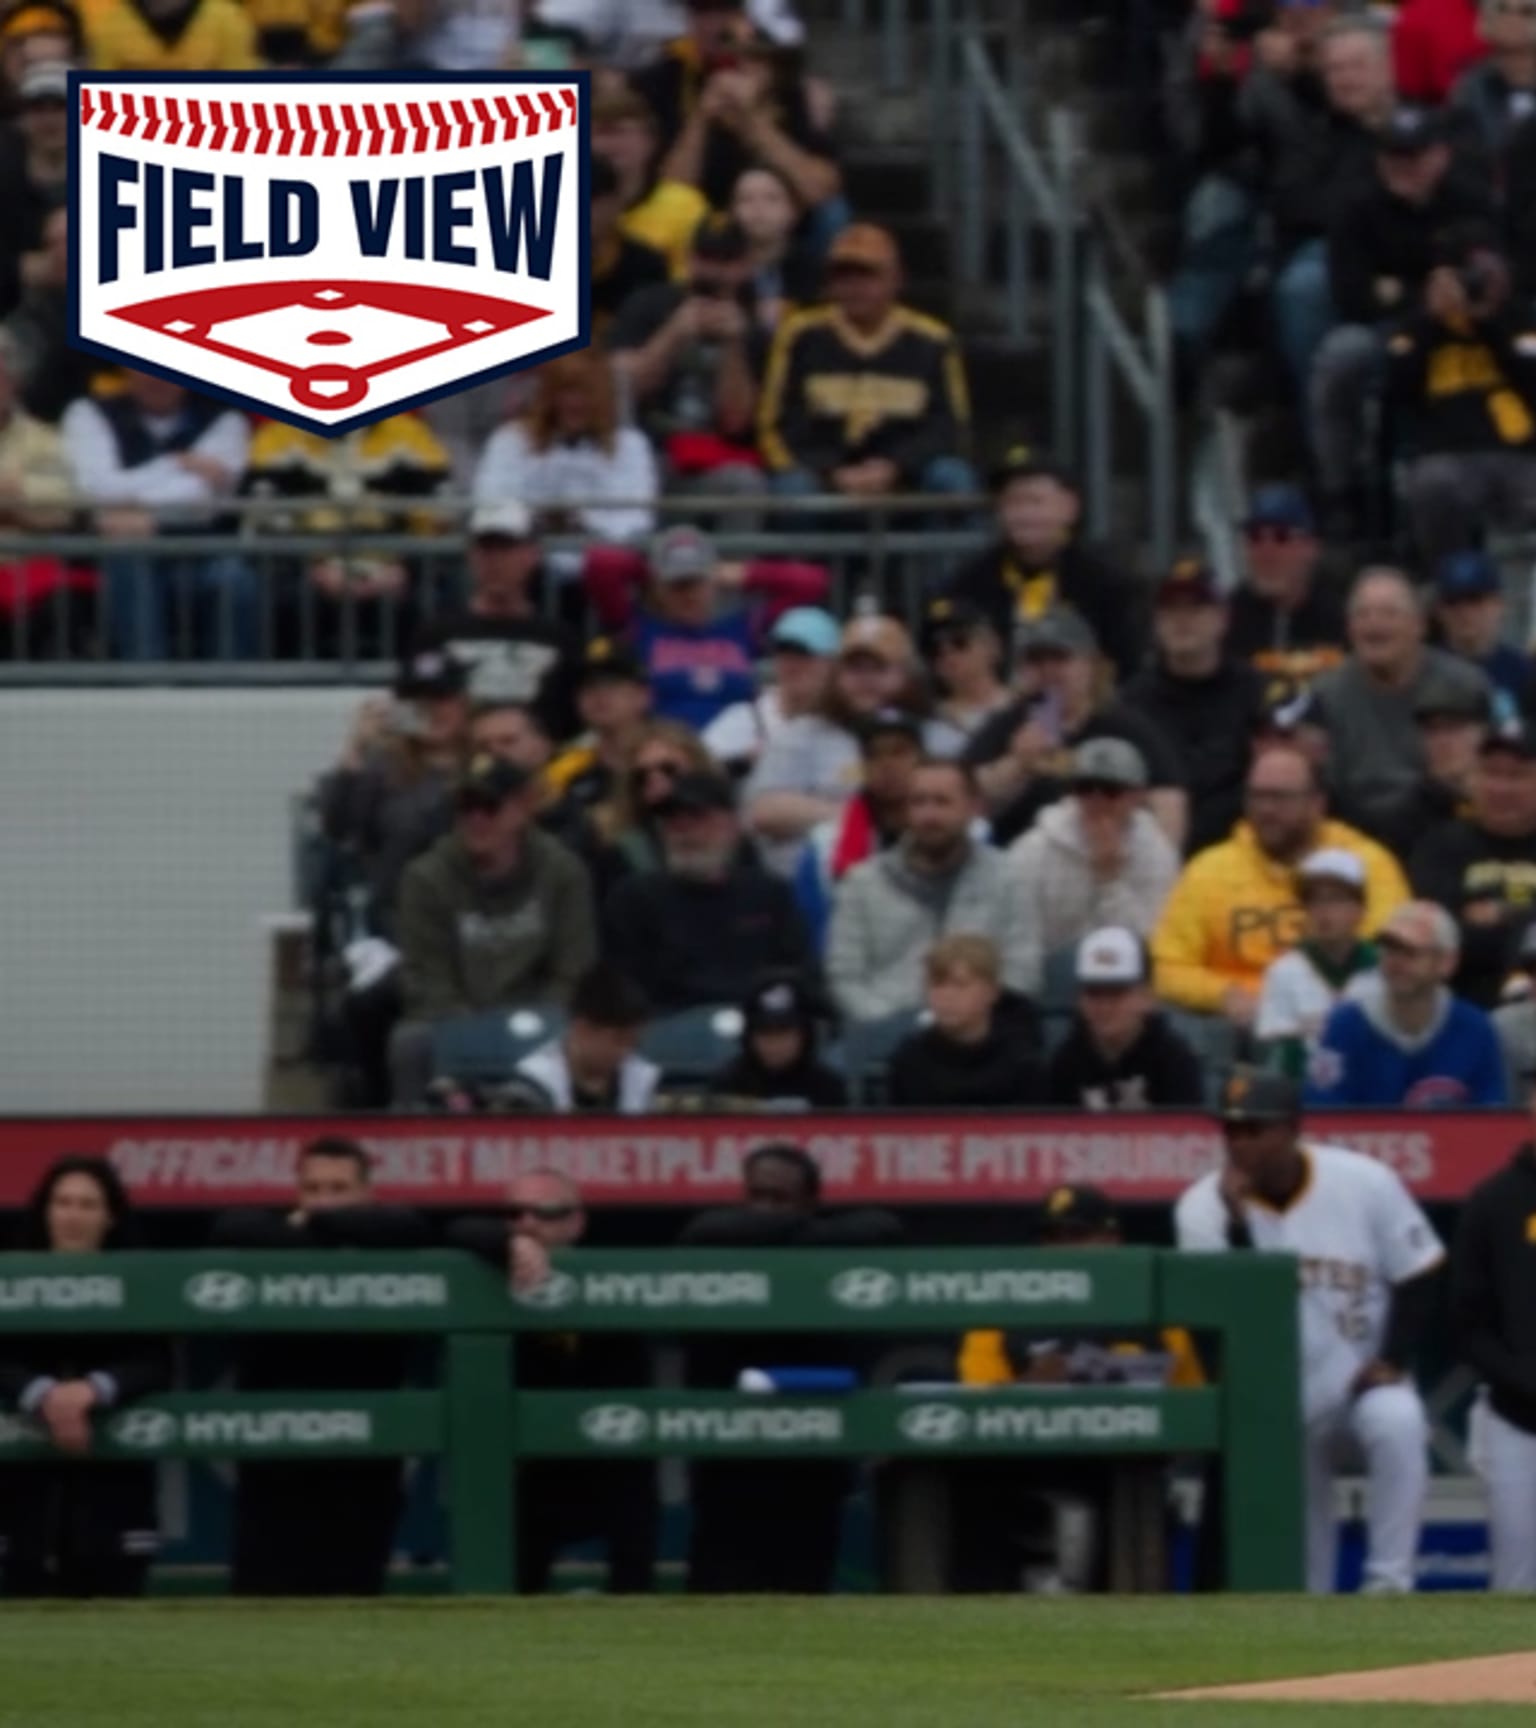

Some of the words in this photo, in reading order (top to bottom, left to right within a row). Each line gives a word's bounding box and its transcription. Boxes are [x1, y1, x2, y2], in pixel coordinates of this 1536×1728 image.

[111, 1138, 299, 1186] OFFICIAL
[355, 1137, 460, 1184] CKET
[472, 1136, 785, 1185] MARKETPLA
[871, 1136, 957, 1183] THE
[0, 1276, 122, 1308] UNDAI
[260, 1275, 447, 1307] HYUNDAI
[583, 1272, 769, 1304] HYUNDAI
[905, 1270, 1091, 1303] HYUNDAI
[184, 1410, 371, 1443] HYUNDAI
[656, 1408, 843, 1441] HYUNDAI
[973, 1406, 1160, 1440] HYUNDAI
